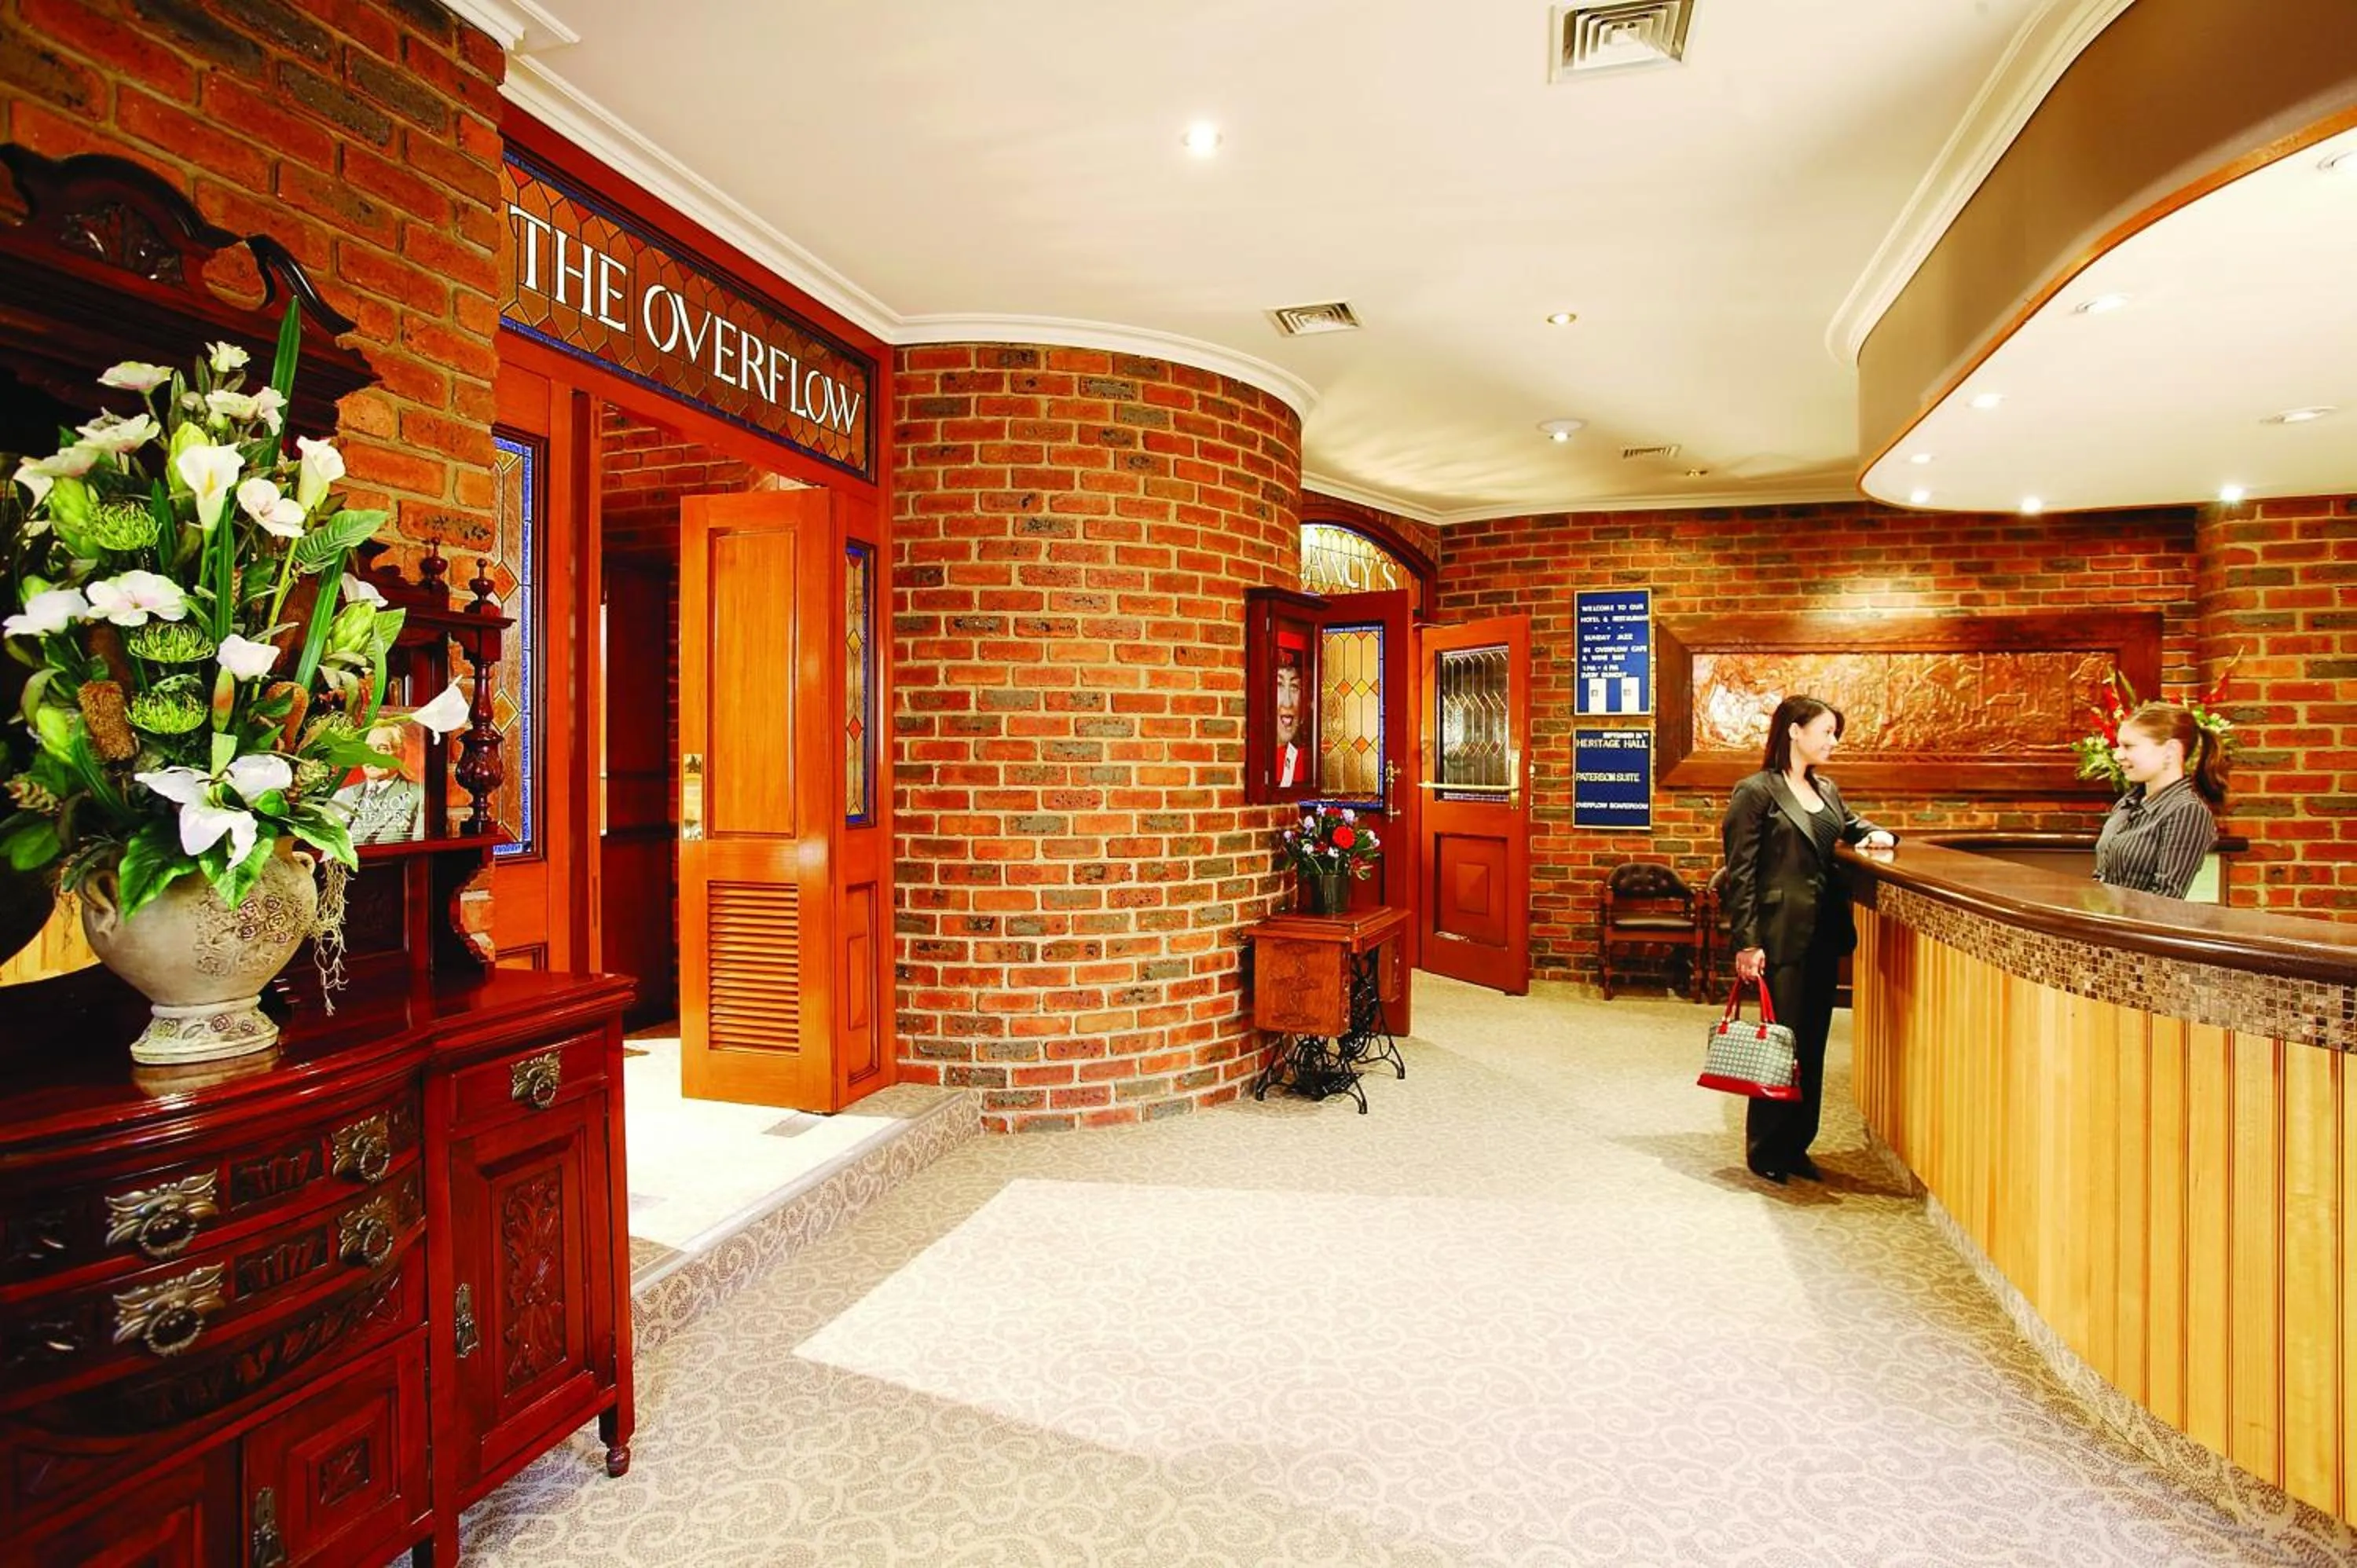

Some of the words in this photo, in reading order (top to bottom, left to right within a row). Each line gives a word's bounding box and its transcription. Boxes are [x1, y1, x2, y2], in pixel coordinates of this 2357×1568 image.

[509, 203, 627, 333] THE
[643, 284, 861, 435] OVERFLOW
[1300, 547, 1396, 591] ANCY'S
[1577, 738, 1621, 749] HERITAGE
[1623, 739, 1648, 749] HALL
